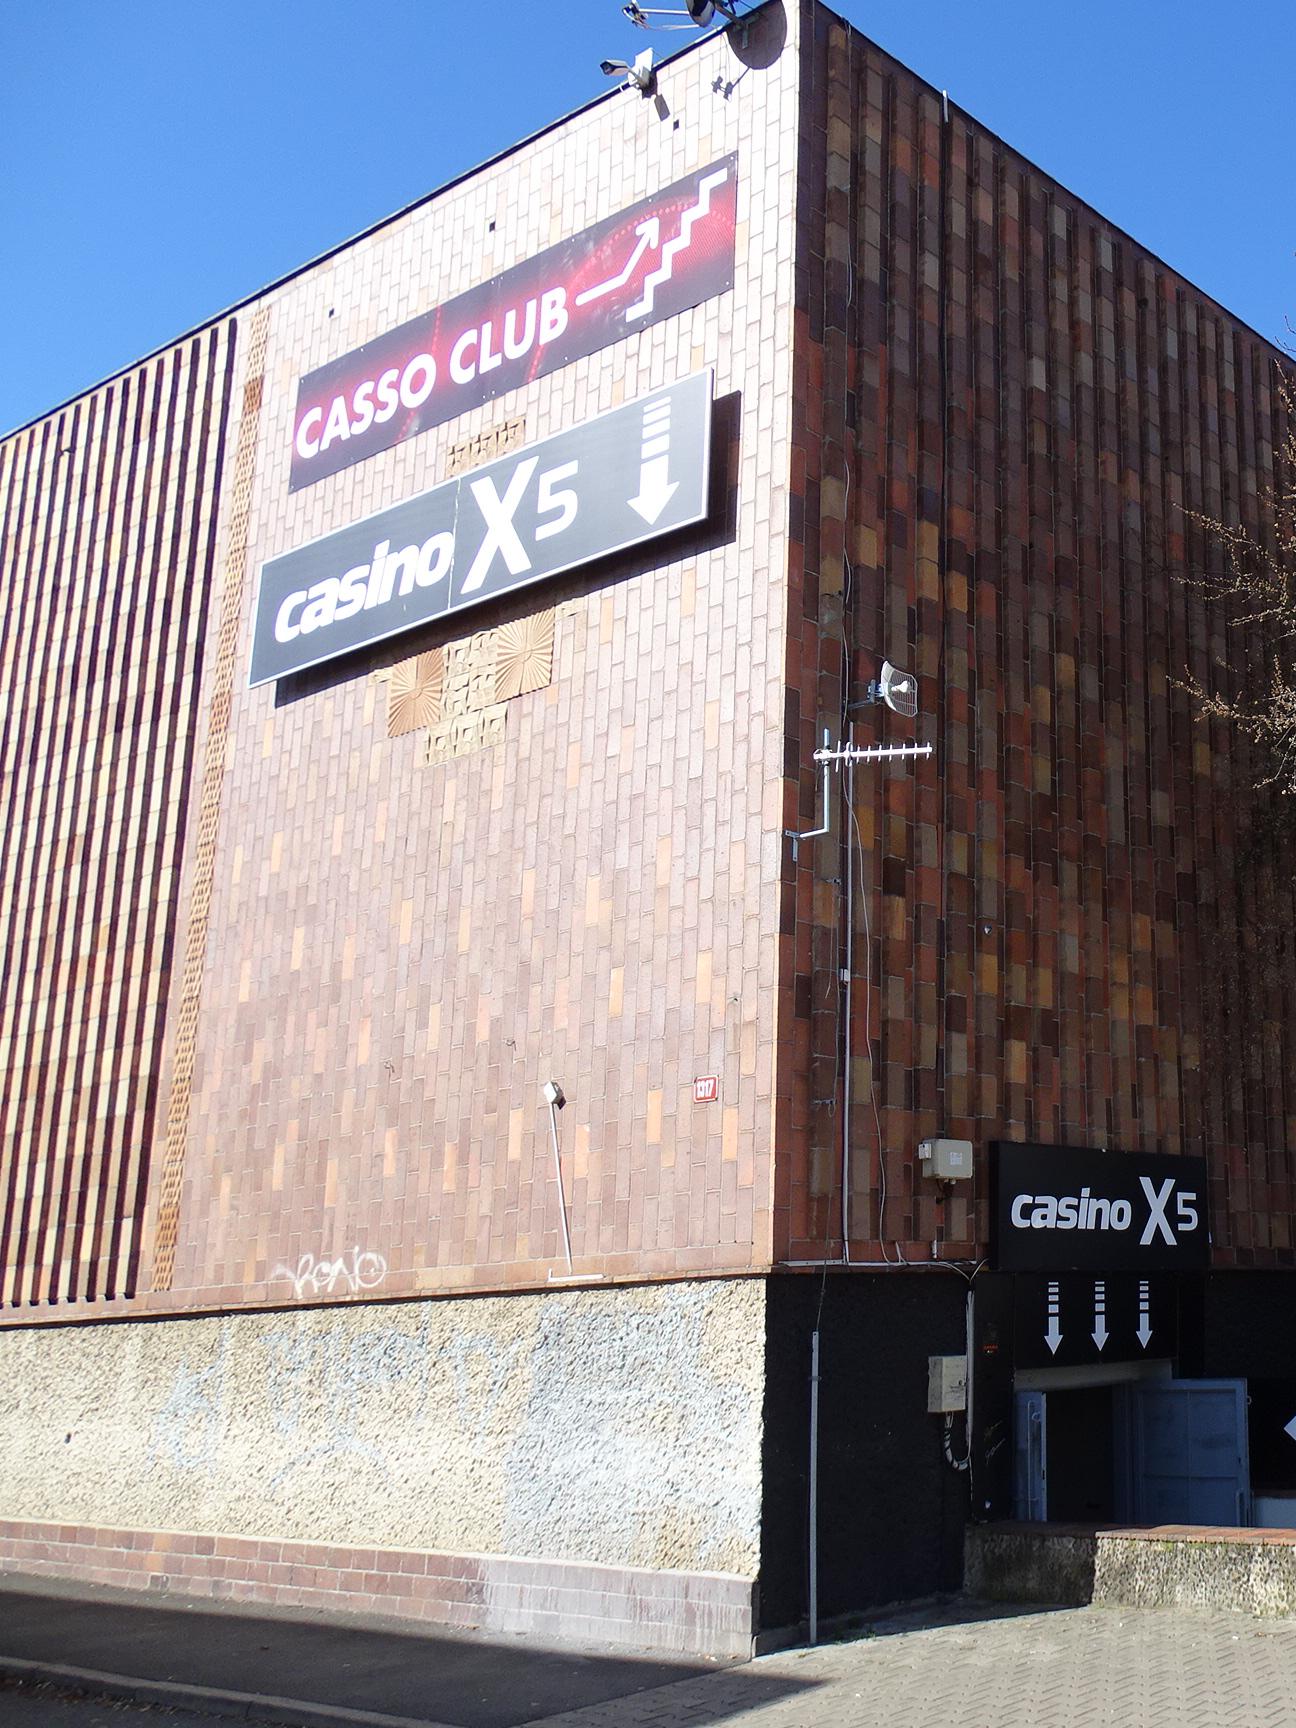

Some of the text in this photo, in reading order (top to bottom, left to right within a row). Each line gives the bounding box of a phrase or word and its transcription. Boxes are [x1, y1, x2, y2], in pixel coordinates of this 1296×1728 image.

[296, 286, 569, 459] CASSO CLUB
[273, 455, 579, 643] casino X5
[1011, 1176, 1199, 1246] casino X5
